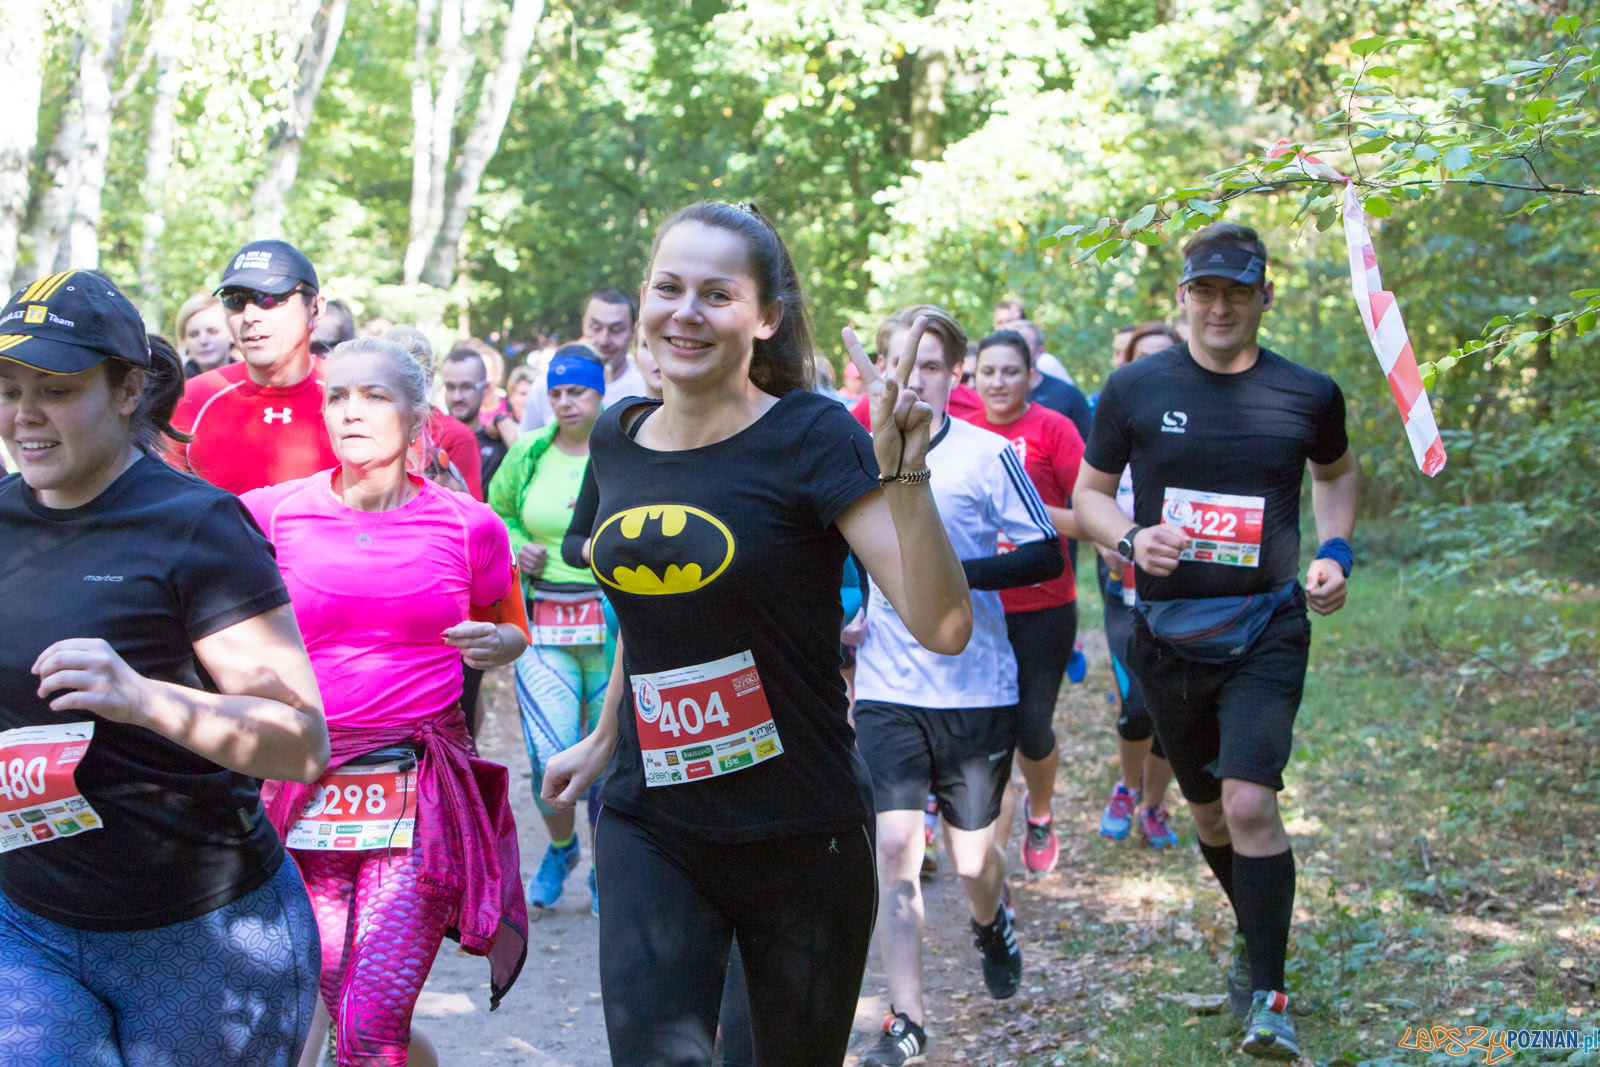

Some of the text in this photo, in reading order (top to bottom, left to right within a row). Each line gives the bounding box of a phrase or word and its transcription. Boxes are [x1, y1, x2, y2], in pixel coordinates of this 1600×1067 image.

[48, 312, 75, 327] Team
[1191, 510, 1237, 538] 422
[555, 604, 590, 625] 117
[659, 691, 730, 737] 404
[0, 756, 47, 800] 480
[323, 784, 386, 815] 298
